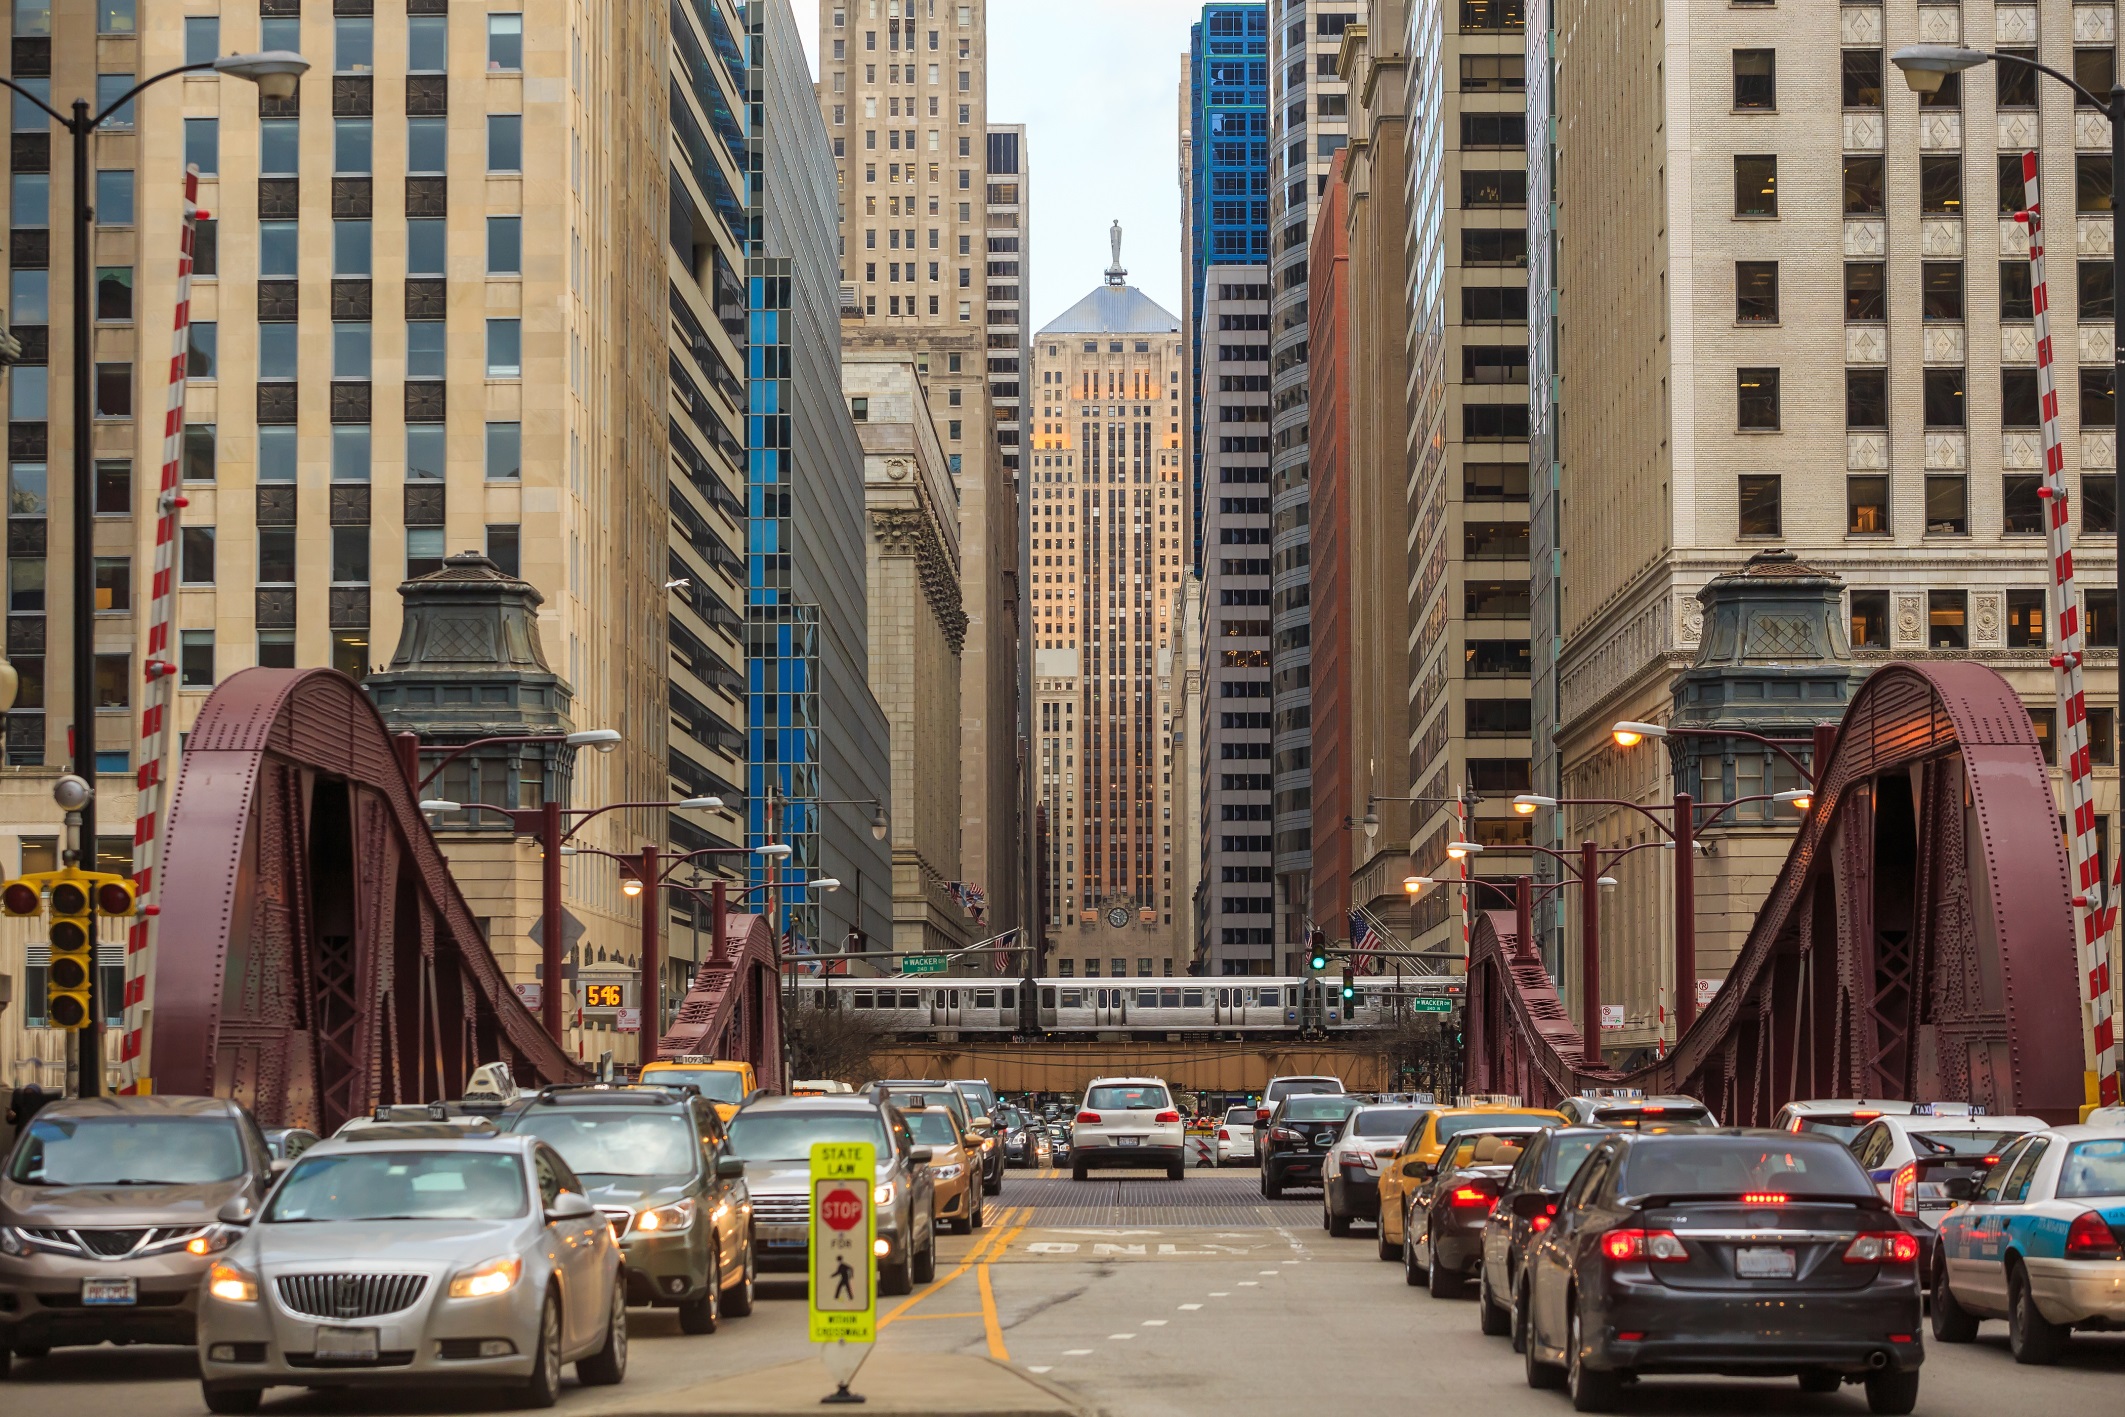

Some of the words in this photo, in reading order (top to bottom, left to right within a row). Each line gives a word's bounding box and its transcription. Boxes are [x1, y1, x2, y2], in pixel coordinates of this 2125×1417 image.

[1456, 1096, 1471, 1108] TAXI
[1508, 1096, 1522, 1108] TAXI
[1915, 1105, 1932, 1115] TAXI
[1968, 1106, 1985, 1116] TAXI
[822, 1147, 862, 1160] STATE
[827, 1164, 855, 1175] LAW
[823, 1201, 860, 1219] STOP
[831, 1239, 851, 1249] FOR
[1026, 1242, 1271, 1255] ONLY
[828, 1316, 857, 1324] WITHIN
[816, 1328, 867, 1337] CROSSWALK
